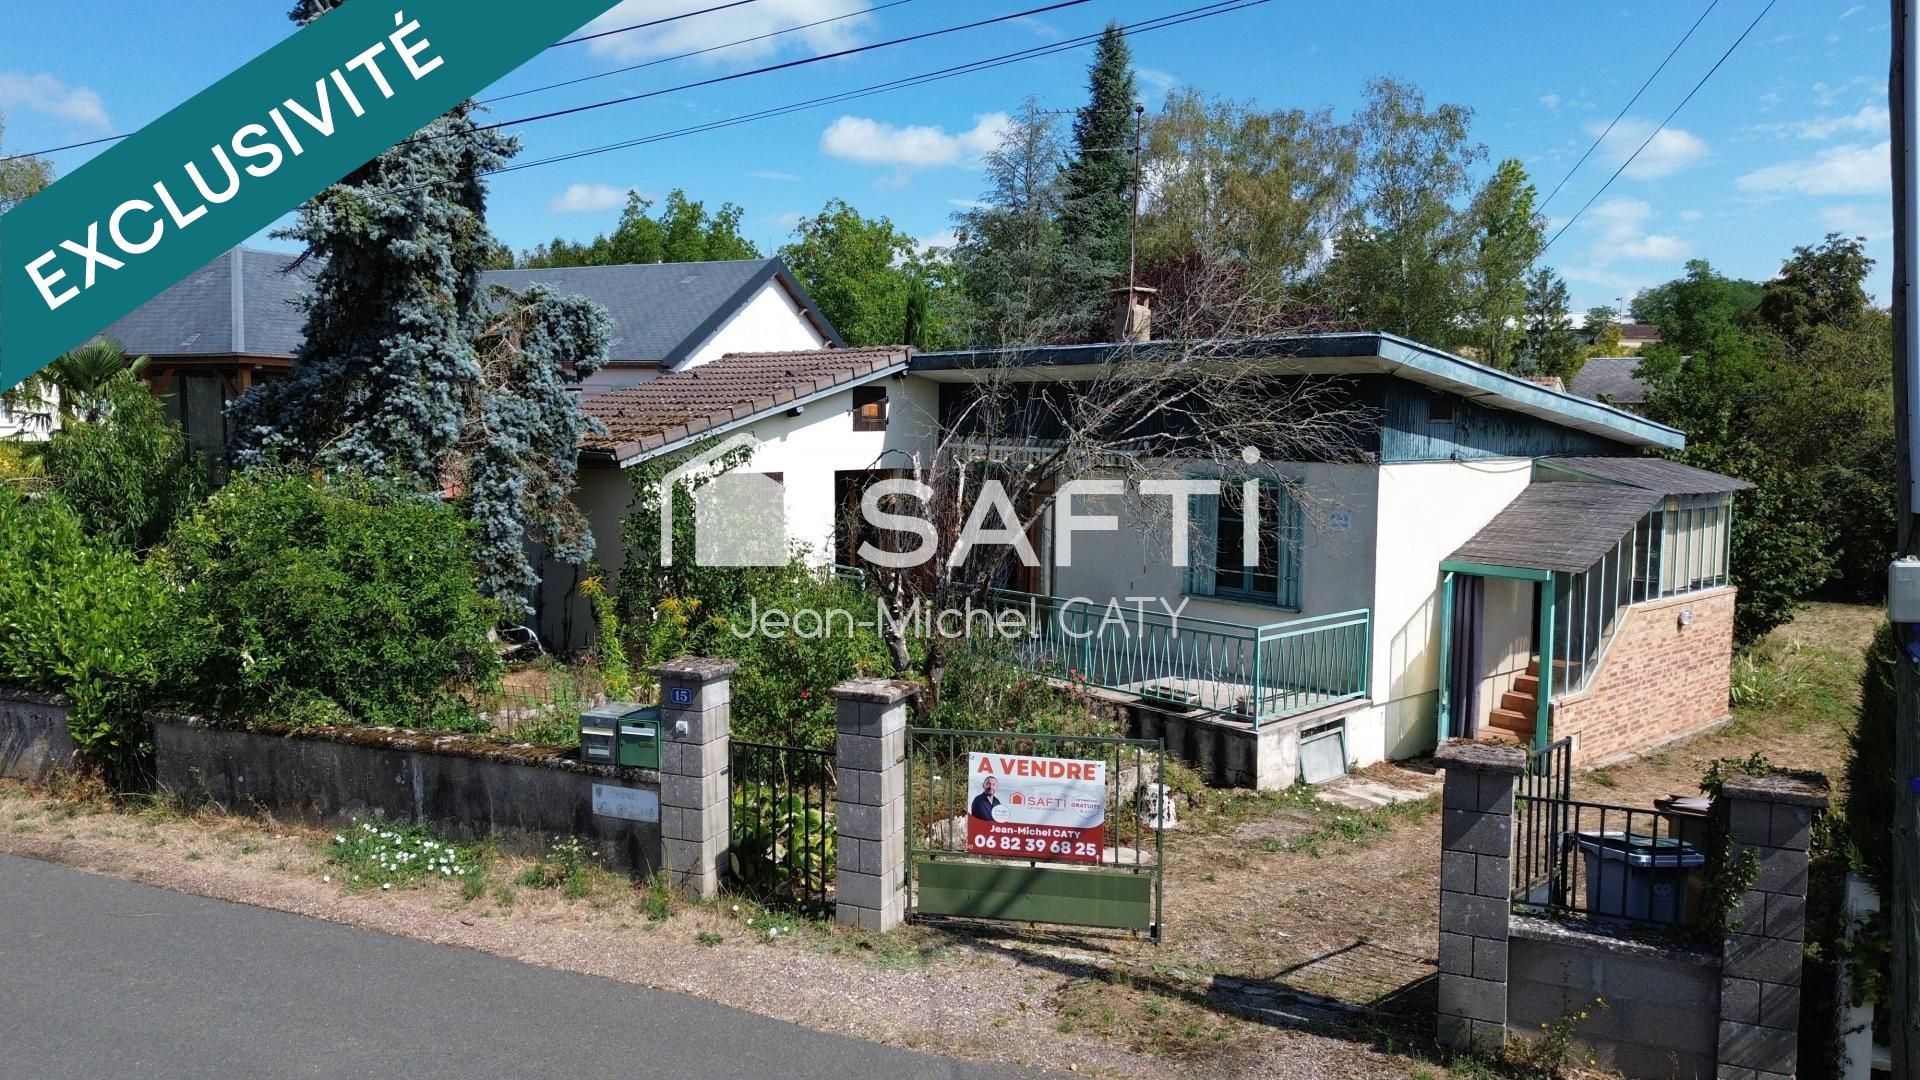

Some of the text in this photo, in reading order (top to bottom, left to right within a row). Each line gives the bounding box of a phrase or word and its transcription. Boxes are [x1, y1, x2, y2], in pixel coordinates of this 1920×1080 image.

[675, 690, 687, 702] 15
[977, 756, 1096, 781] A VENDRE
[990, 825, 1081, 839] Jean-Michel CATY
[974, 834, 1096, 856] 06 82 39 68 25
